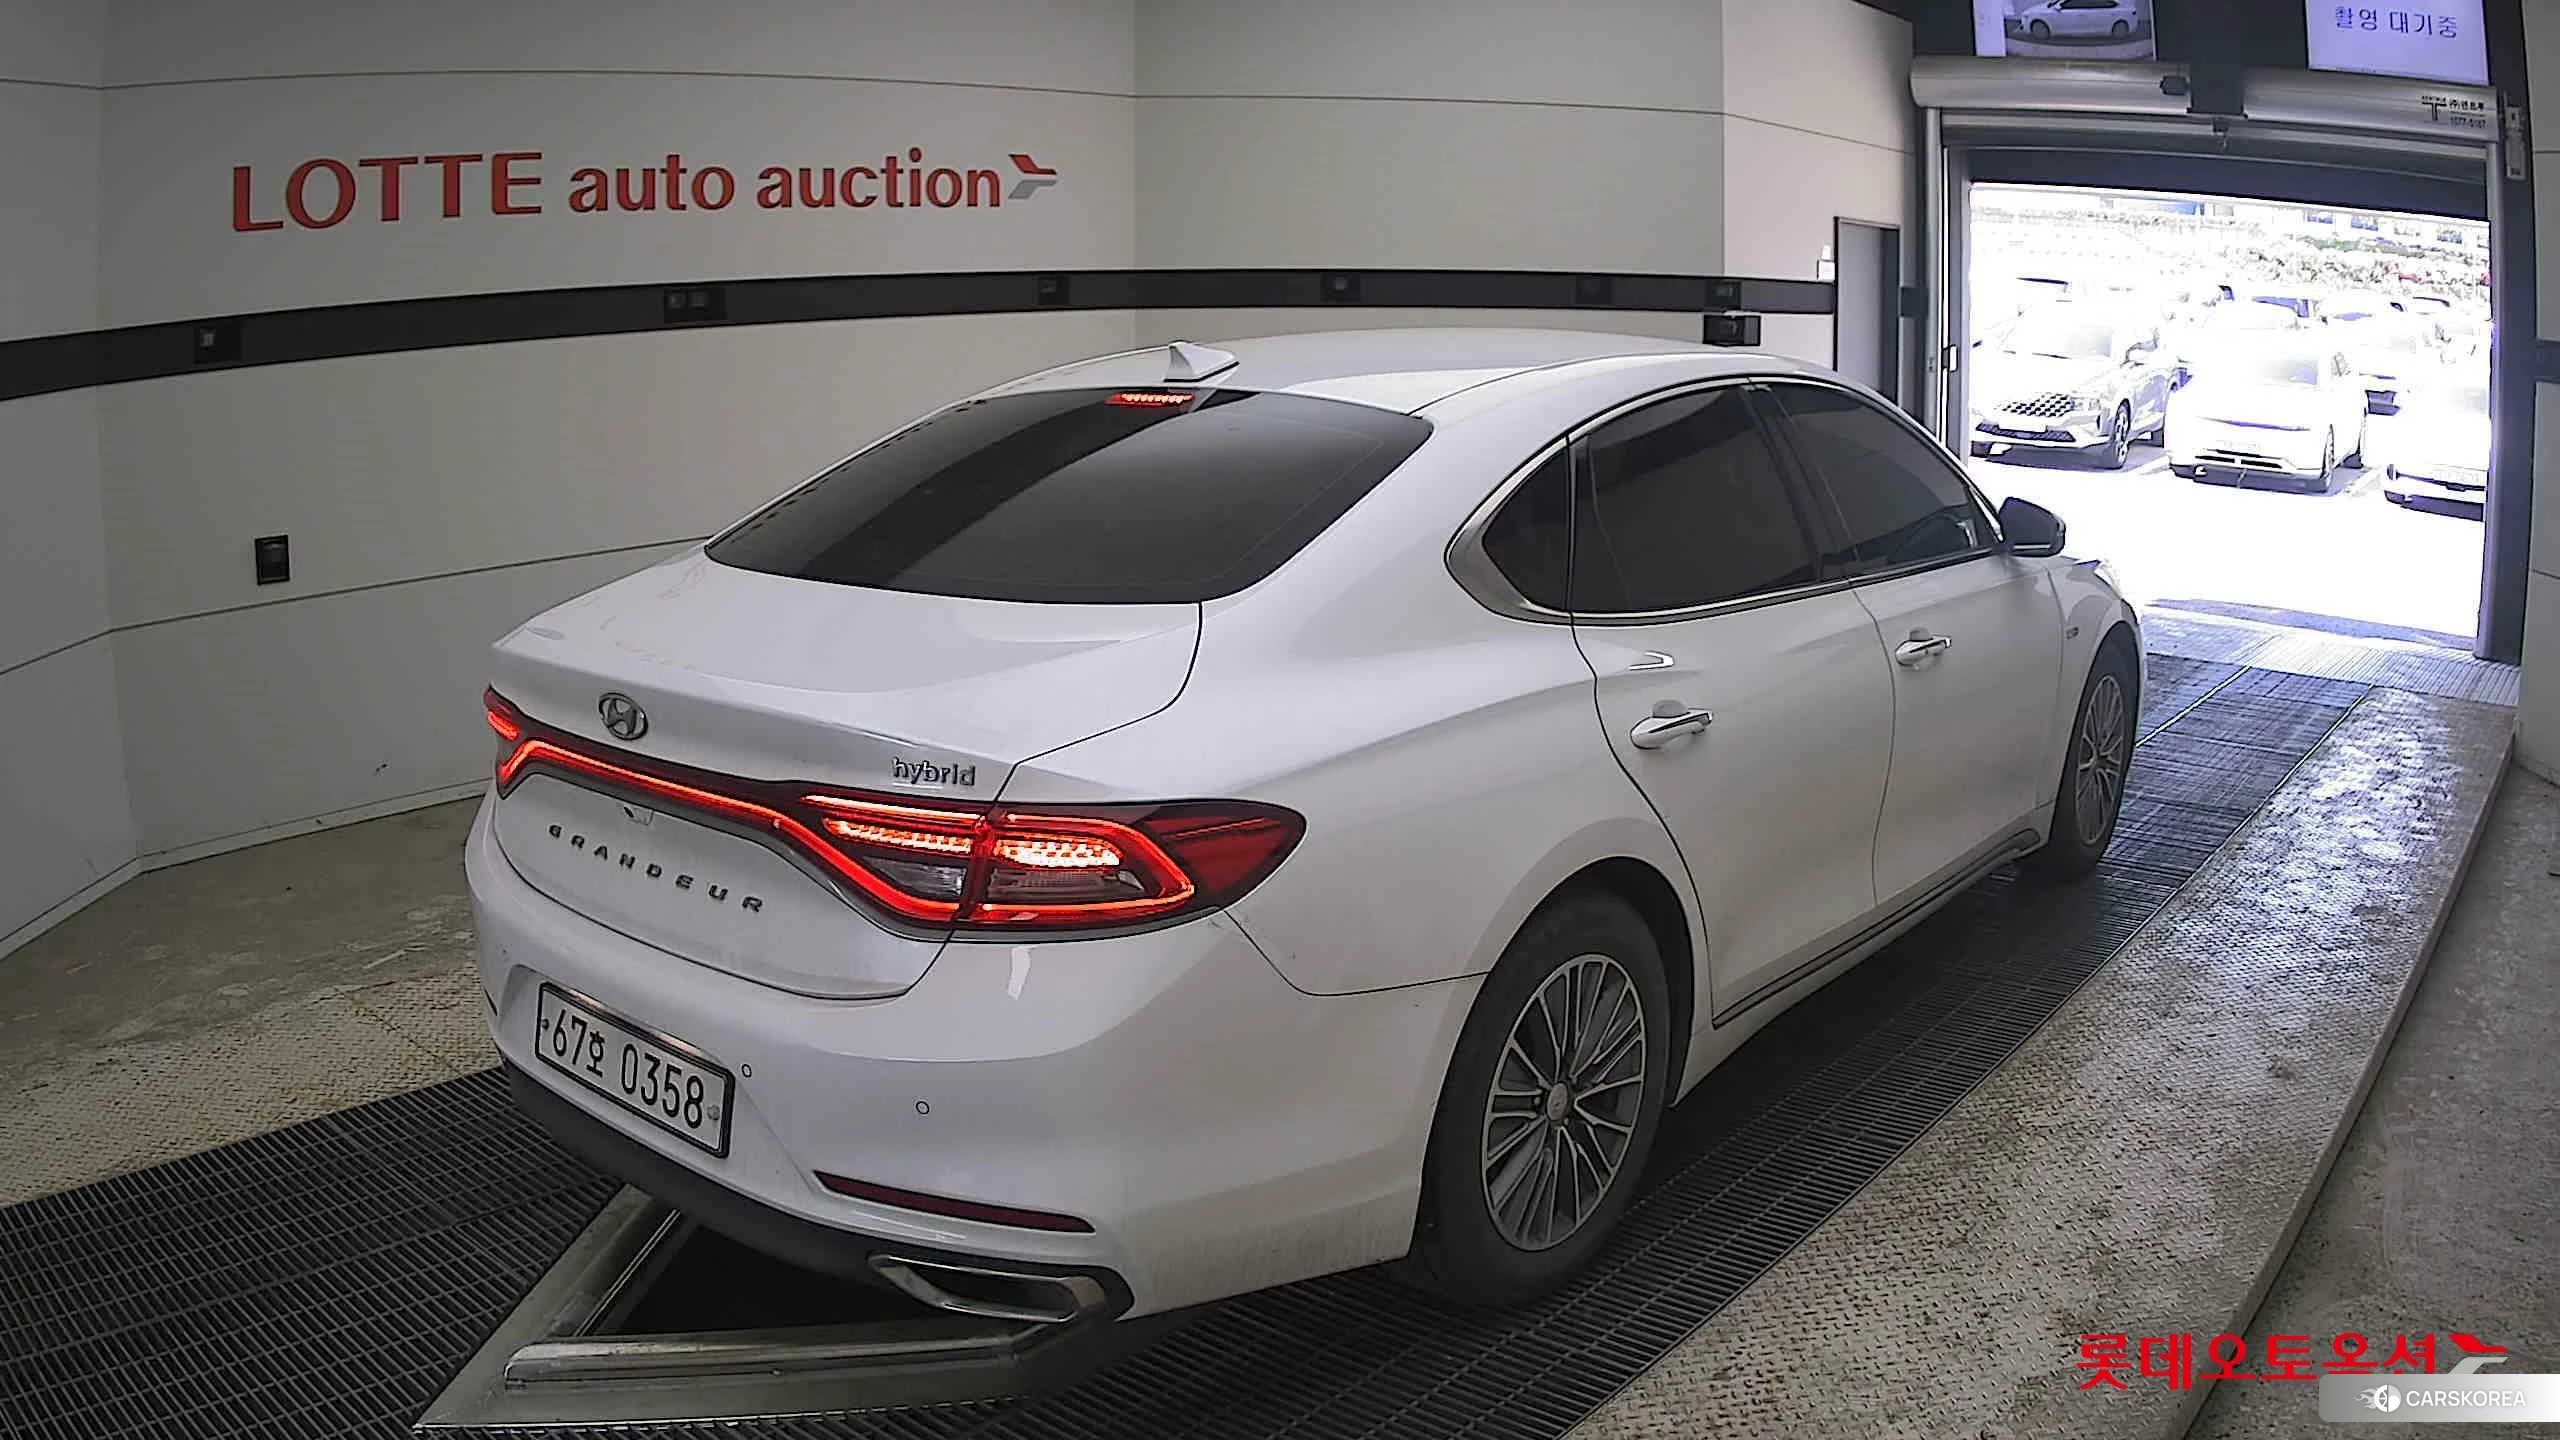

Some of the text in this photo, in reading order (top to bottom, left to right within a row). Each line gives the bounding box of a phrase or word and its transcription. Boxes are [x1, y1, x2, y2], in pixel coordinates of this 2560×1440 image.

[2336, 6, 2378, 31] 촬영
[232, 147, 1001, 233] LOTTE auto auction
[891, 756, 976, 786] hybrid
[548, 824, 763, 913] GRANDEUR
[552, 1009, 704, 1129] 67호 0358
